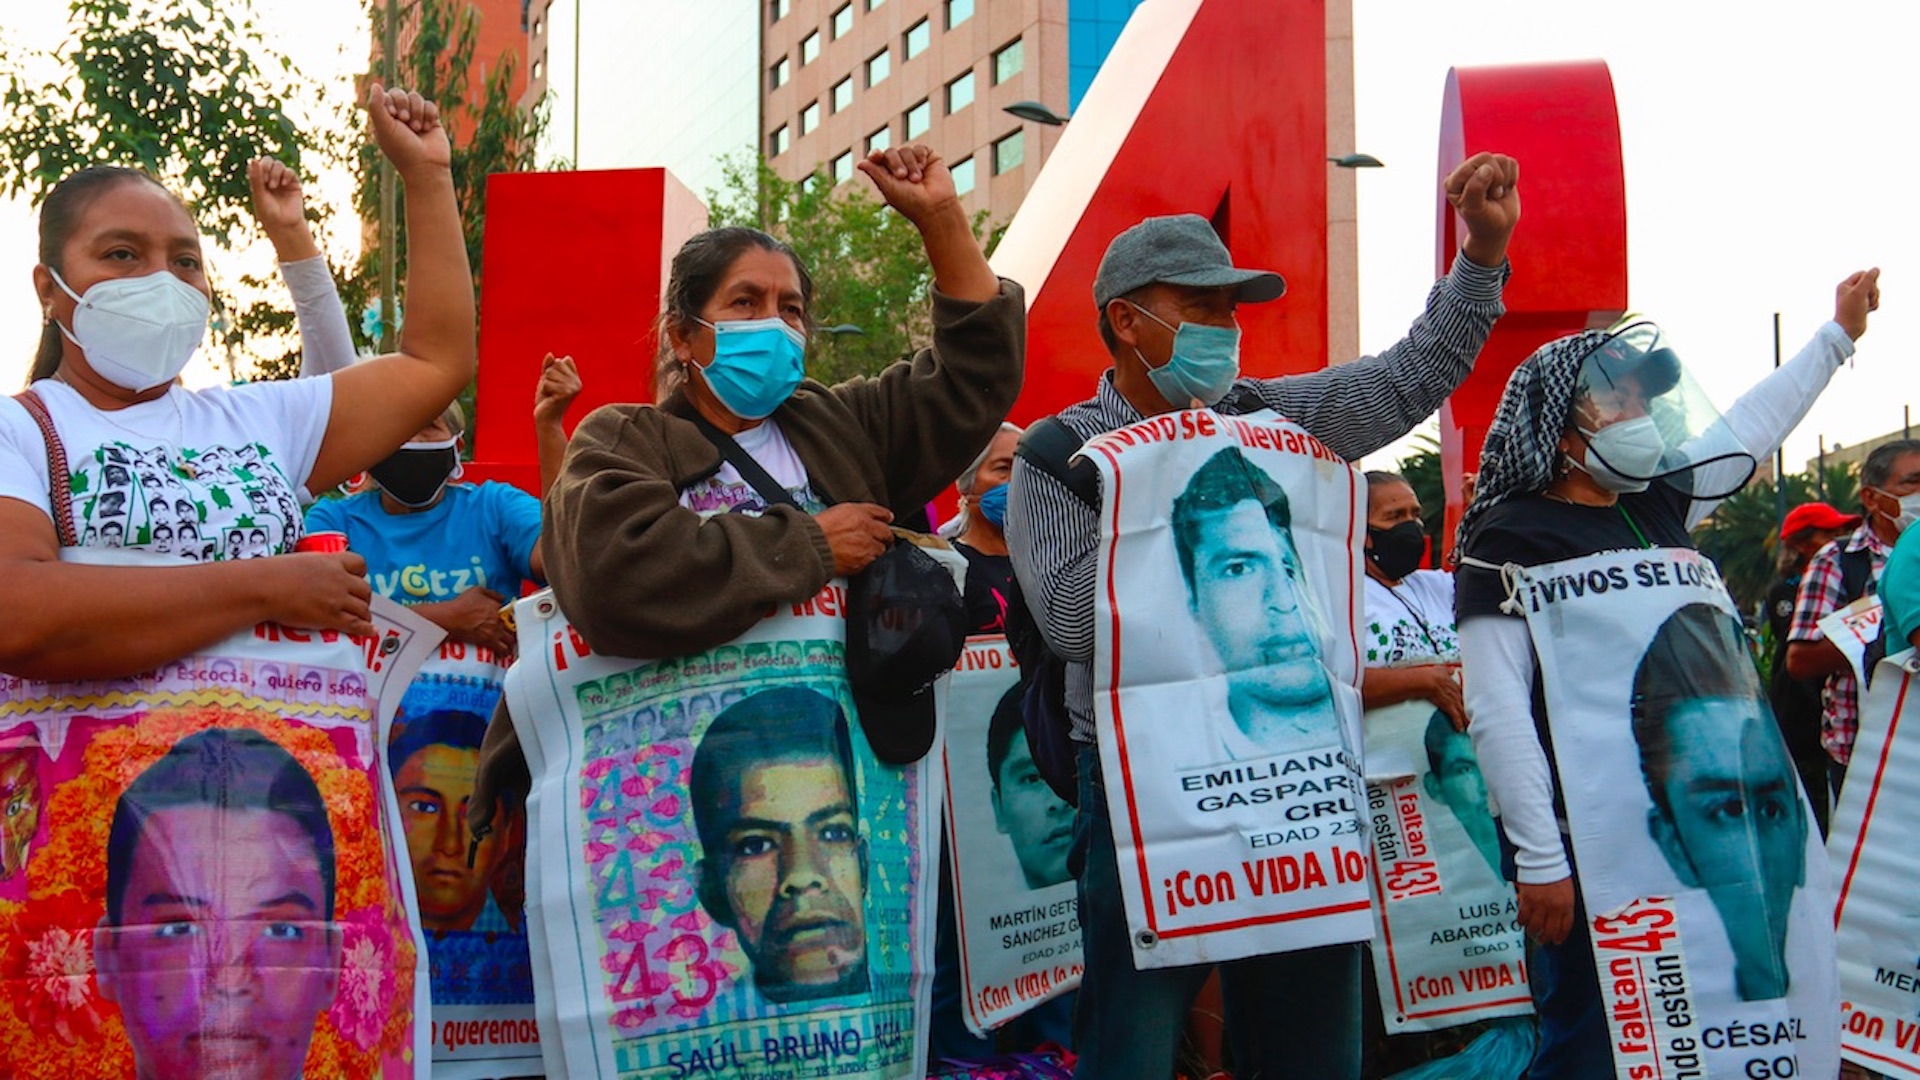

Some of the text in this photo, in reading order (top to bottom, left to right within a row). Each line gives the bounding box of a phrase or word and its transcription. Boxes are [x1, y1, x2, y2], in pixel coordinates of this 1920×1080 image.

[1633, 560, 1670, 588] SE
[177, 665, 257, 687] Escocia,
[268, 674, 323, 693] quiero
[1250, 819, 1359, 849] EDAD 23
[1373, 813, 1401, 862] están
[1398, 792, 1428, 858] faltan
[1163, 869, 1236, 916] ¡Con
[1241, 851, 1328, 898] VIDA
[989, 905, 1047, 931] MARTÍN
[1459, 902, 1501, 921] LUIS
[1002, 921, 1067, 949] SÁNCHEZ
[1430, 922, 1508, 945] ABARCA
[1463, 940, 1510, 958] EDAD
[1022, 947, 1055, 965] EDAD
[1057, 942, 1071, 955] 20
[611, 933, 718, 1018] 43
[1408, 974, 1455, 1006] ¡Con
[1458, 963, 1515, 993] VIDA
[1650, 954, 1692, 1028] están
[977, 984, 1014, 1019] ¡Con
[1014, 969, 1053, 1003] VIDA
[1609, 957, 1648, 1054] faltan
[442, 1019, 540, 1053] queremos
[667, 1037, 746, 1080] SAÚL
[763, 1028, 862, 1066] BRUNO
